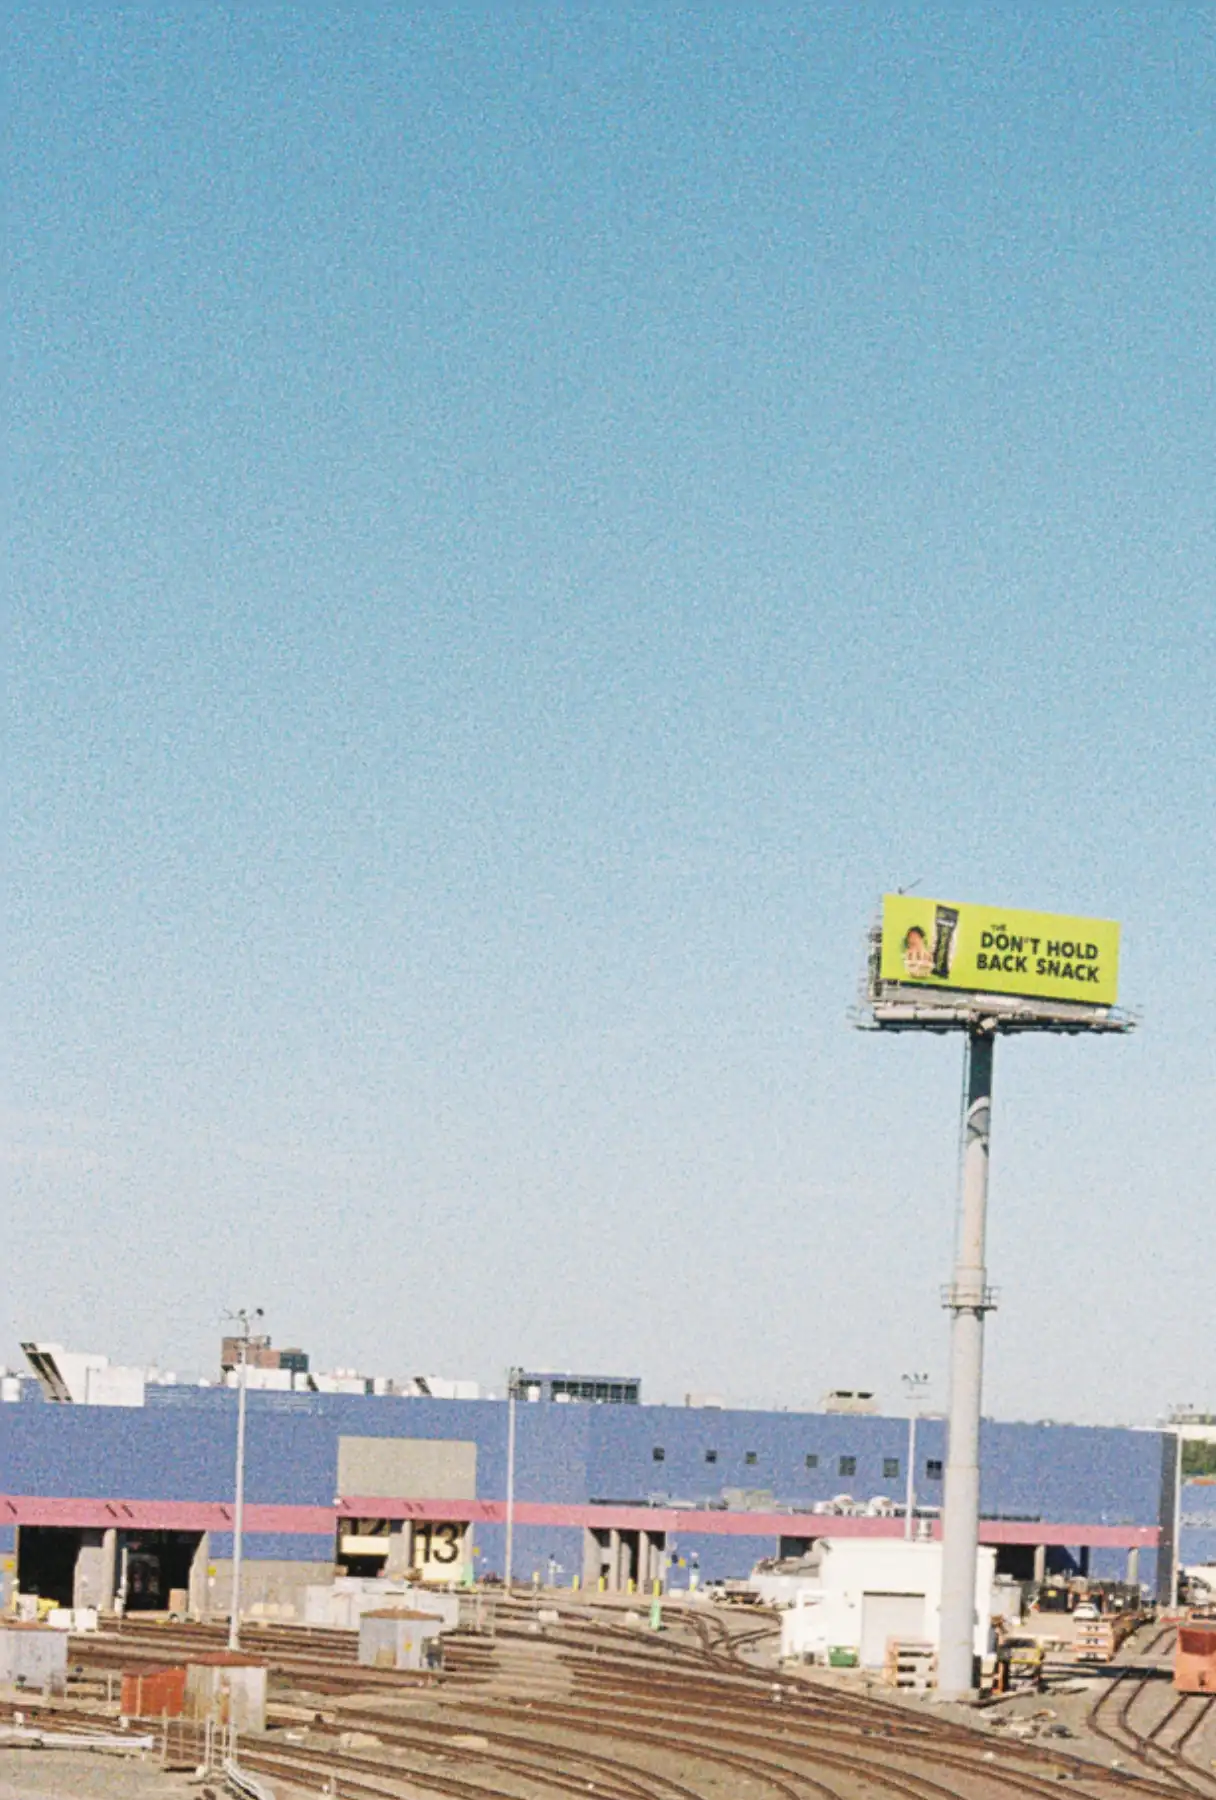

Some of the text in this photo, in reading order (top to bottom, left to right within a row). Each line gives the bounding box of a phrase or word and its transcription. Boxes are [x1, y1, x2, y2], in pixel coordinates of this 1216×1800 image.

[981, 931, 1098, 960] DON'T HOLD
[977, 953, 1100, 983] BACK SNACK
[416, 1523, 459, 1564] 13
